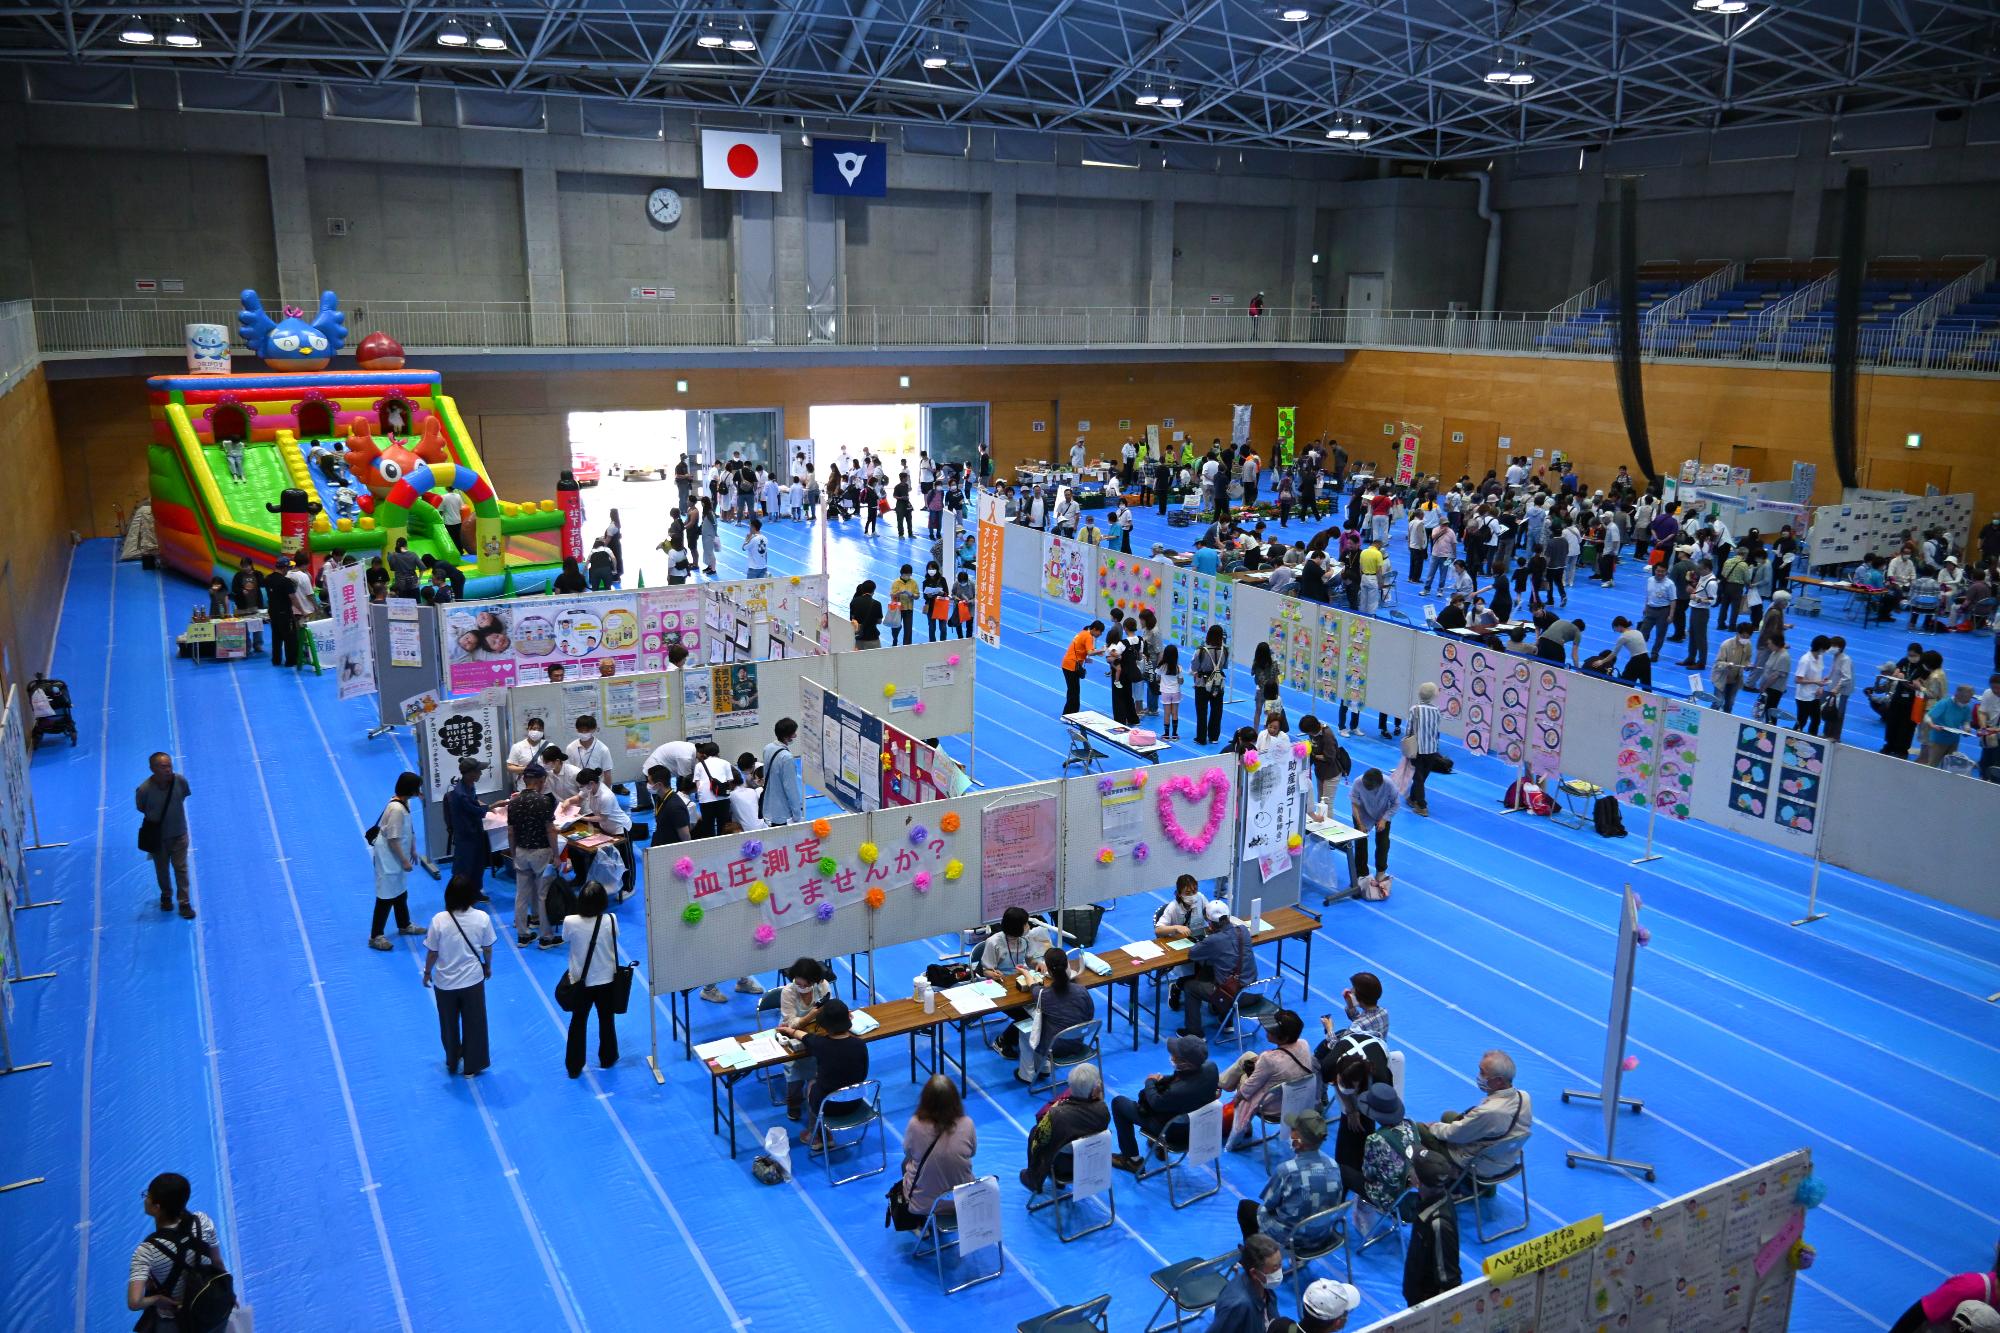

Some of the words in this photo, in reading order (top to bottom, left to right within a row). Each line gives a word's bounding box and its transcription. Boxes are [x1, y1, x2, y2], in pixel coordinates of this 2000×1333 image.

[1399, 437, 1416, 485] 直売所
[979, 527, 991, 625] オレンジリボン運動
[987, 528, 999, 607] 子ども虐待防止
[693, 838, 822, 899] 血圧測定
[769, 839, 945, 915] しませんか？
